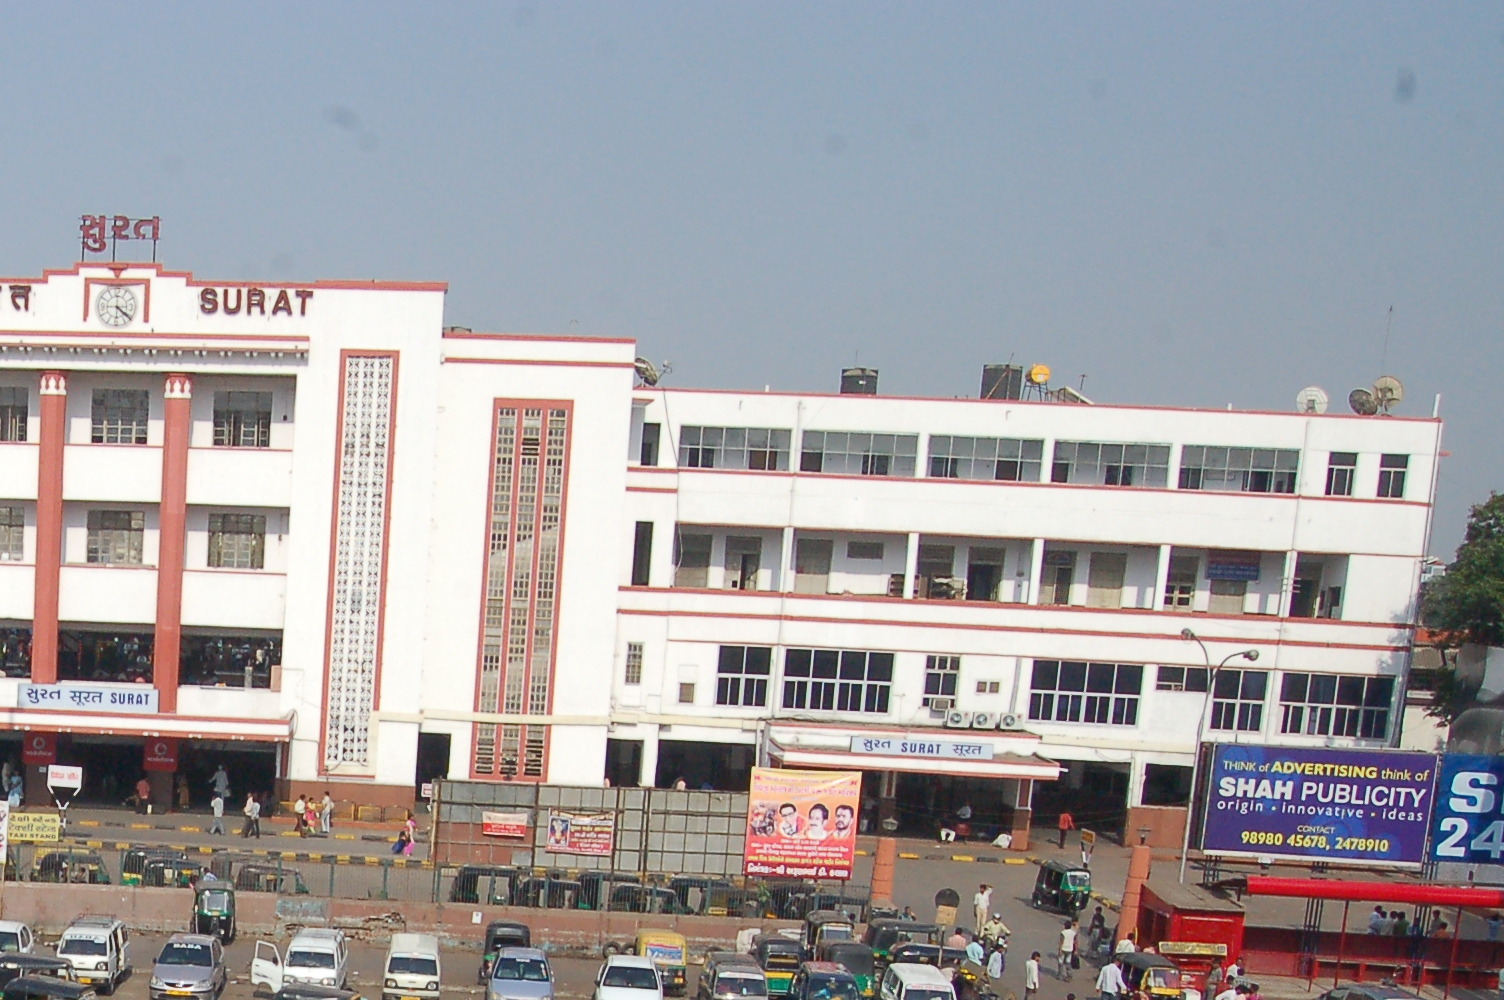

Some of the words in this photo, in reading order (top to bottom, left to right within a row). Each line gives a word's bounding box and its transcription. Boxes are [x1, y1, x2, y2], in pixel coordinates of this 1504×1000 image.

[79, 214, 160, 253] સુરત
[200, 288, 314, 317] SURAT
[27, 688, 61, 704] સુરત
[69, 690, 103, 706] सूरत
[110, 692, 150, 706] SURAT
[863, 739, 891, 752] સુરત
[901, 742, 942, 755] SURAT
[952, 744, 982, 757] सूरत
[1259, 763, 1270, 773] of
[1271, 761, 1378, 779] ADVERTISING
[1381, 768, 1411, 781] think
[1415, 769, 1430, 782] of
[1218, 777, 1294, 800] SHAH
[1301, 781, 1427, 808] PUBLICITY
[1449, 771, 1504, 814] S
[1217, 799, 1264, 815] origin
[1281, 802, 1364, 820] innovative
[1382, 808, 1423, 822] ideas
[1297, 825, 1336, 834] CONTACT
[1241, 831, 1283, 846] 98980
[1287, 834, 1330, 851] 45678,
[1334, 836, 1390, 852] 2478910
